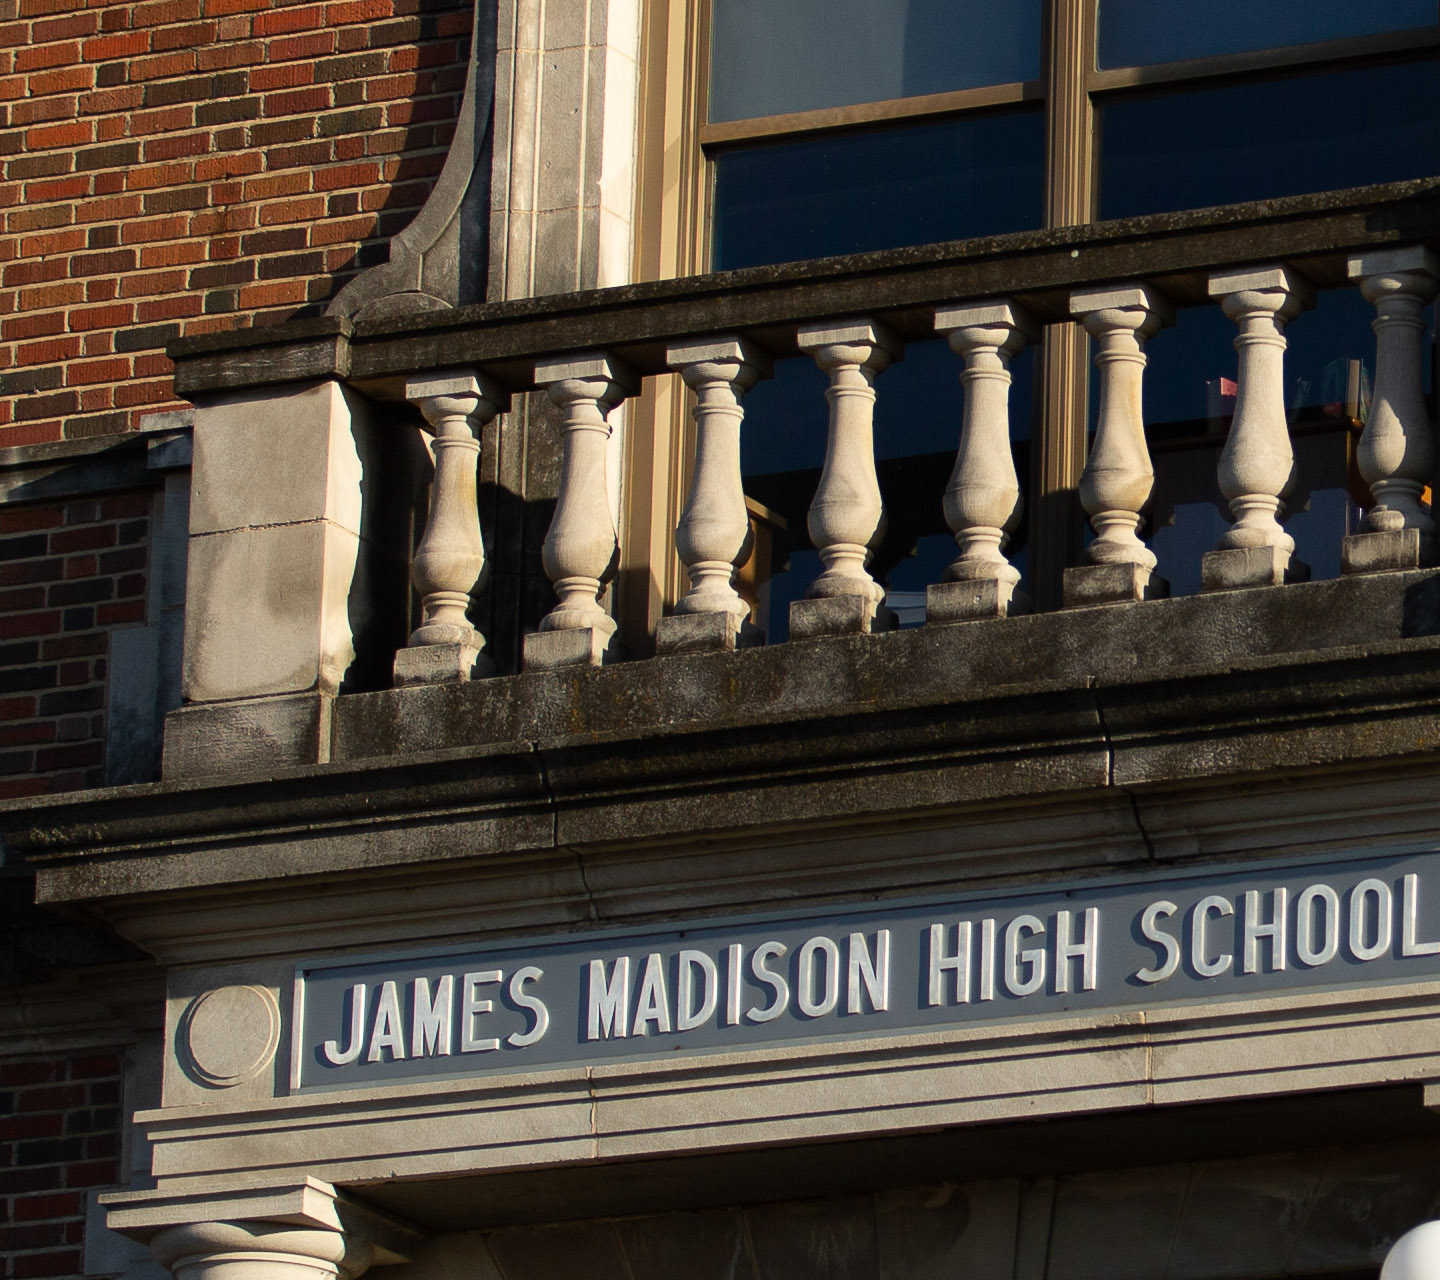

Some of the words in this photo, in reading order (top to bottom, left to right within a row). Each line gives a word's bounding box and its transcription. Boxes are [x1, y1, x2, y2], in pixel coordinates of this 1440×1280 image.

[323, 966, 552, 1069] JAMES
[584, 928, 891, 1042] MADISON
[926, 906, 1101, 1007] HIGH
